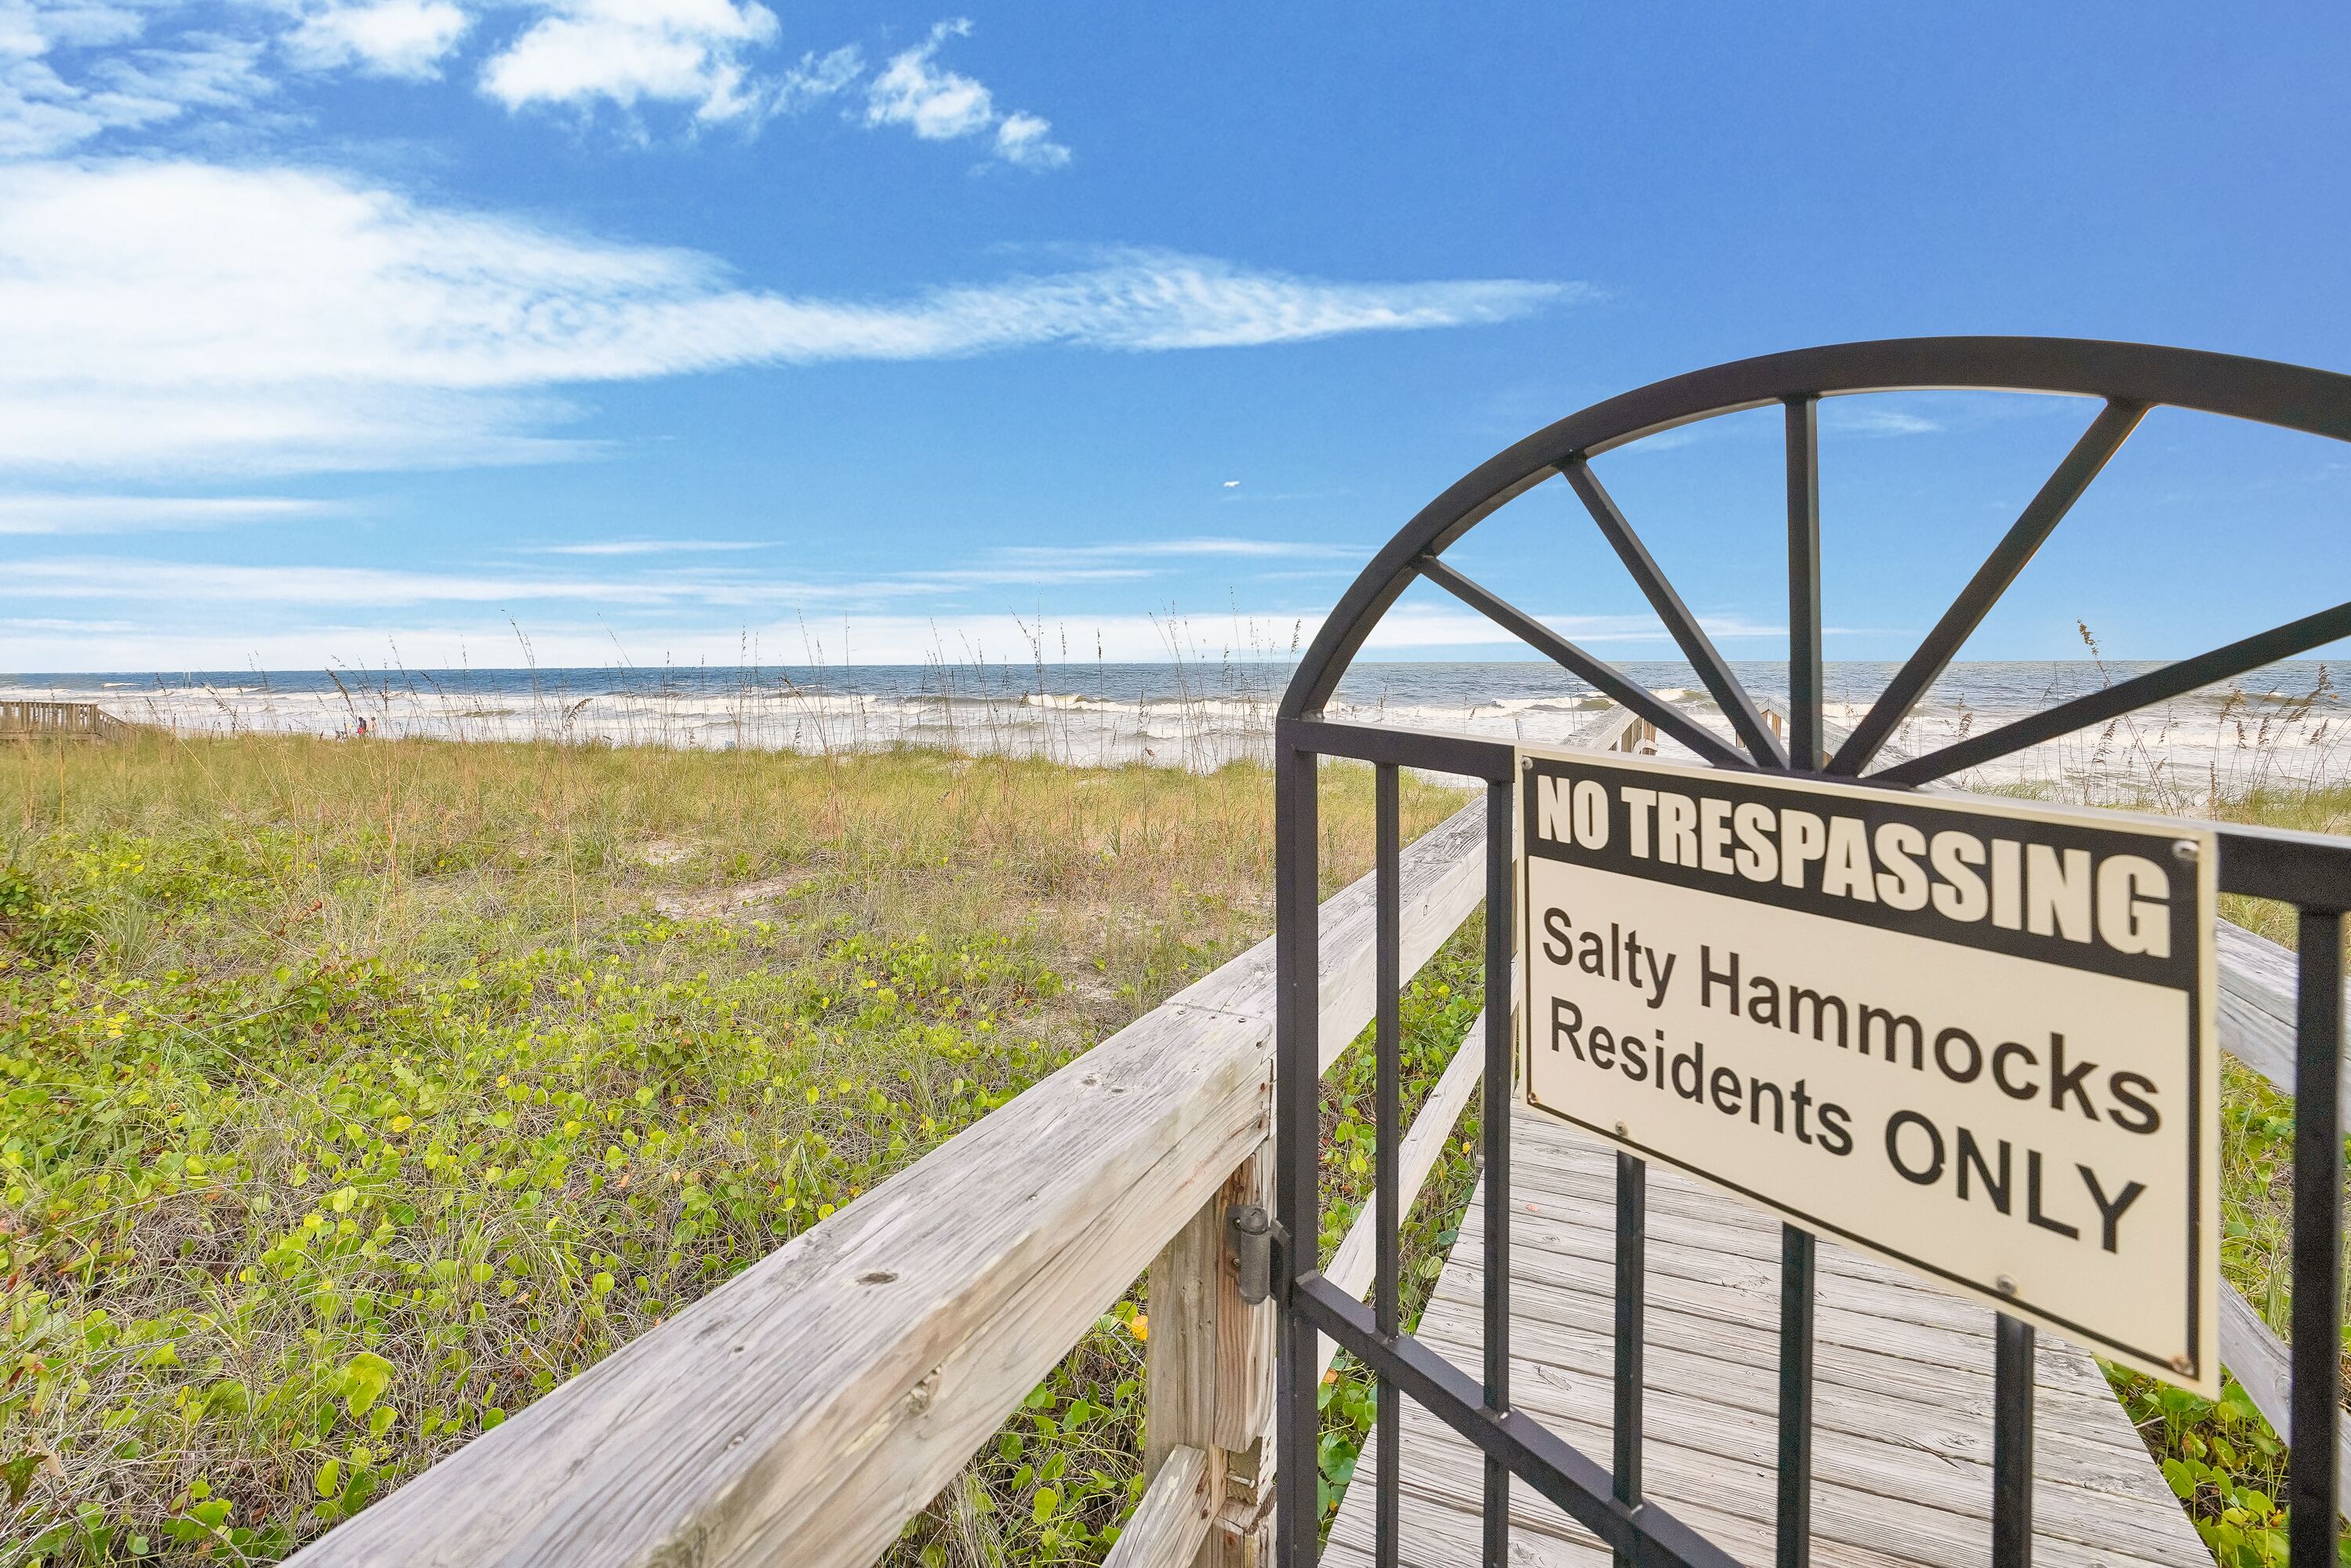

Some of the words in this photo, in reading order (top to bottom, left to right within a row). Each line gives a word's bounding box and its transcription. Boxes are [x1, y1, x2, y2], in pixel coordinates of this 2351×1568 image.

[1536, 775, 1609, 850] NO
[1620, 787, 2171, 959] TRESPASSING
[1543, 907, 1677, 1009] Salty
[1700, 945, 2161, 1135] Hammocks
[1550, 996, 1855, 1156] Residents
[1884, 1109, 2146, 1254] ONLY
